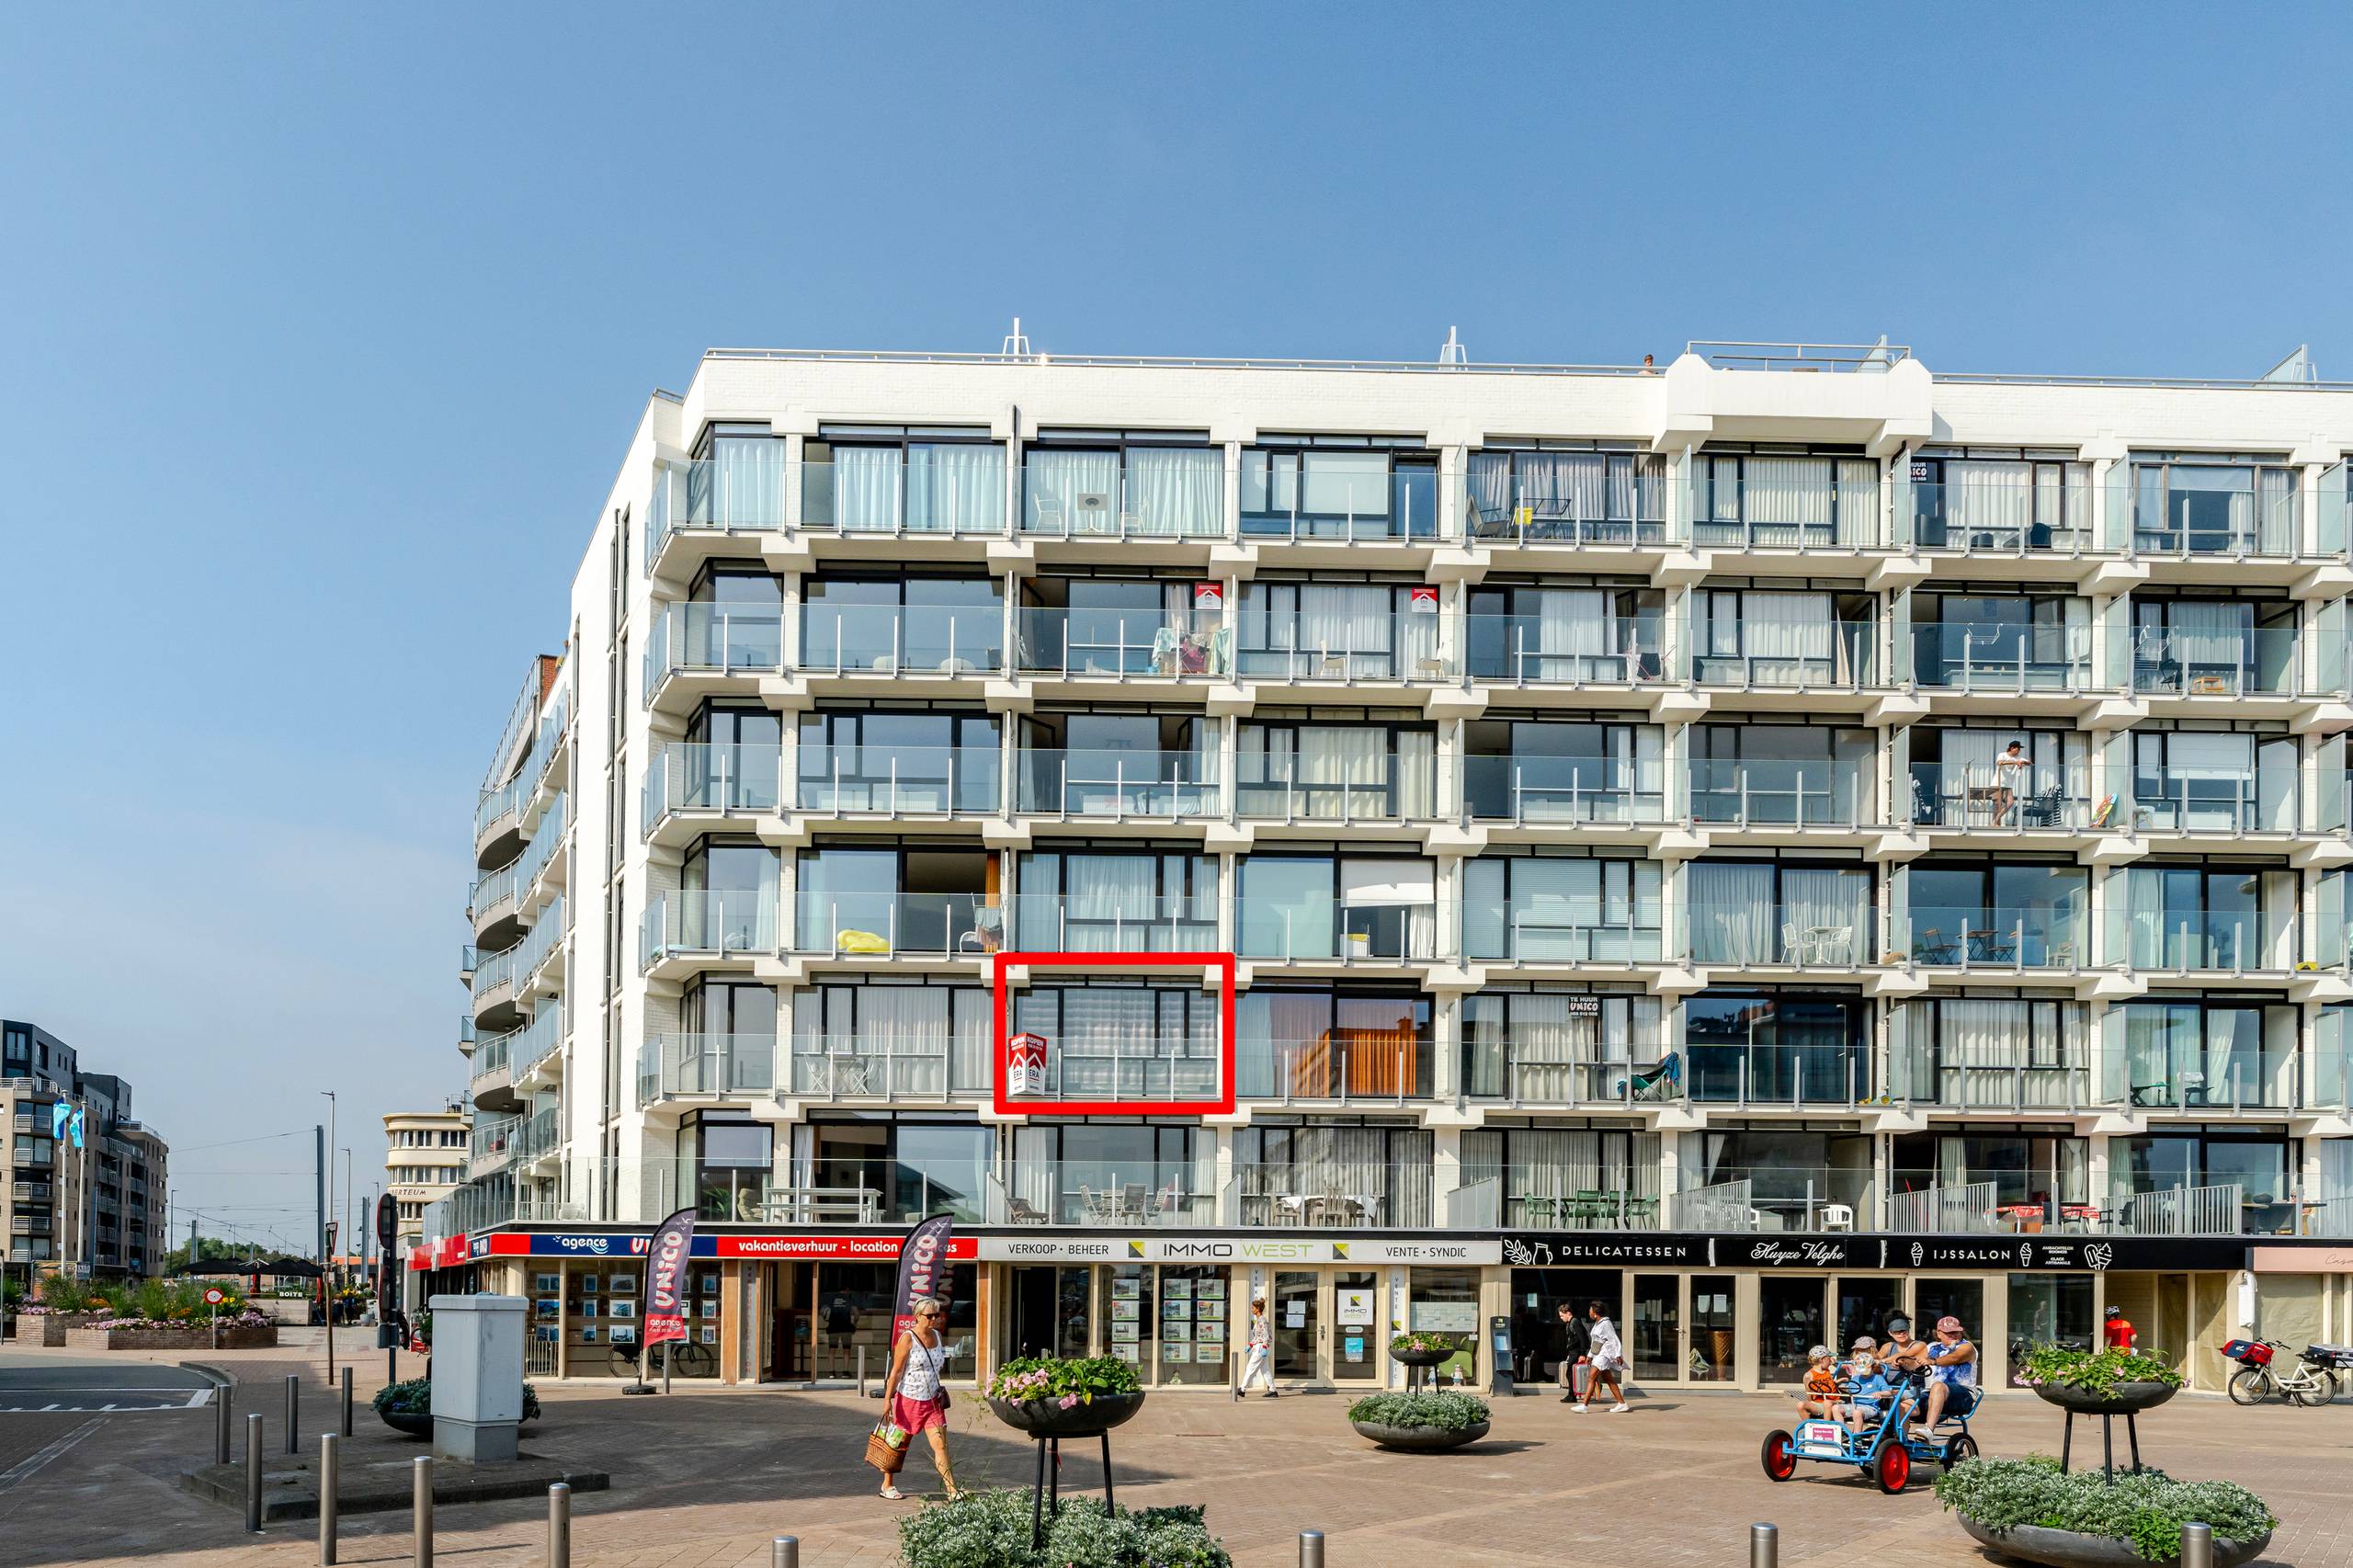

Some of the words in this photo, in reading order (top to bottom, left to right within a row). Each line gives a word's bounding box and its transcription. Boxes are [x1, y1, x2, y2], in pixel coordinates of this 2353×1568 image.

[1011, 1036, 1025, 1047] KOPEN
[1027, 1036, 1044, 1048] KOPEN
[1014, 1070, 1022, 1078] ERA
[1029, 1069, 1040, 1079] ERA
[562, 1237, 608, 1250] agence
[738, 1240, 837, 1253] vakantieverhuur
[850, 1241, 898, 1253] location
[1008, 1244, 1057, 1255] VERKOOP
[1068, 1244, 1109, 1256] BEHEER
[1164, 1244, 1233, 1256] IMMO
[1242, 1244, 1313, 1257] WEST
[1385, 1246, 1419, 1257] VENTE
[1429, 1247, 1467, 1258] SYNDIC
[1563, 1245, 1687, 1257] DELICATESSEN
[1750, 1242, 1801, 1266] Huyze
[1801, 1242, 1845, 1267] Velghe
[1934, 1249, 2010, 1260] IJSSALON
